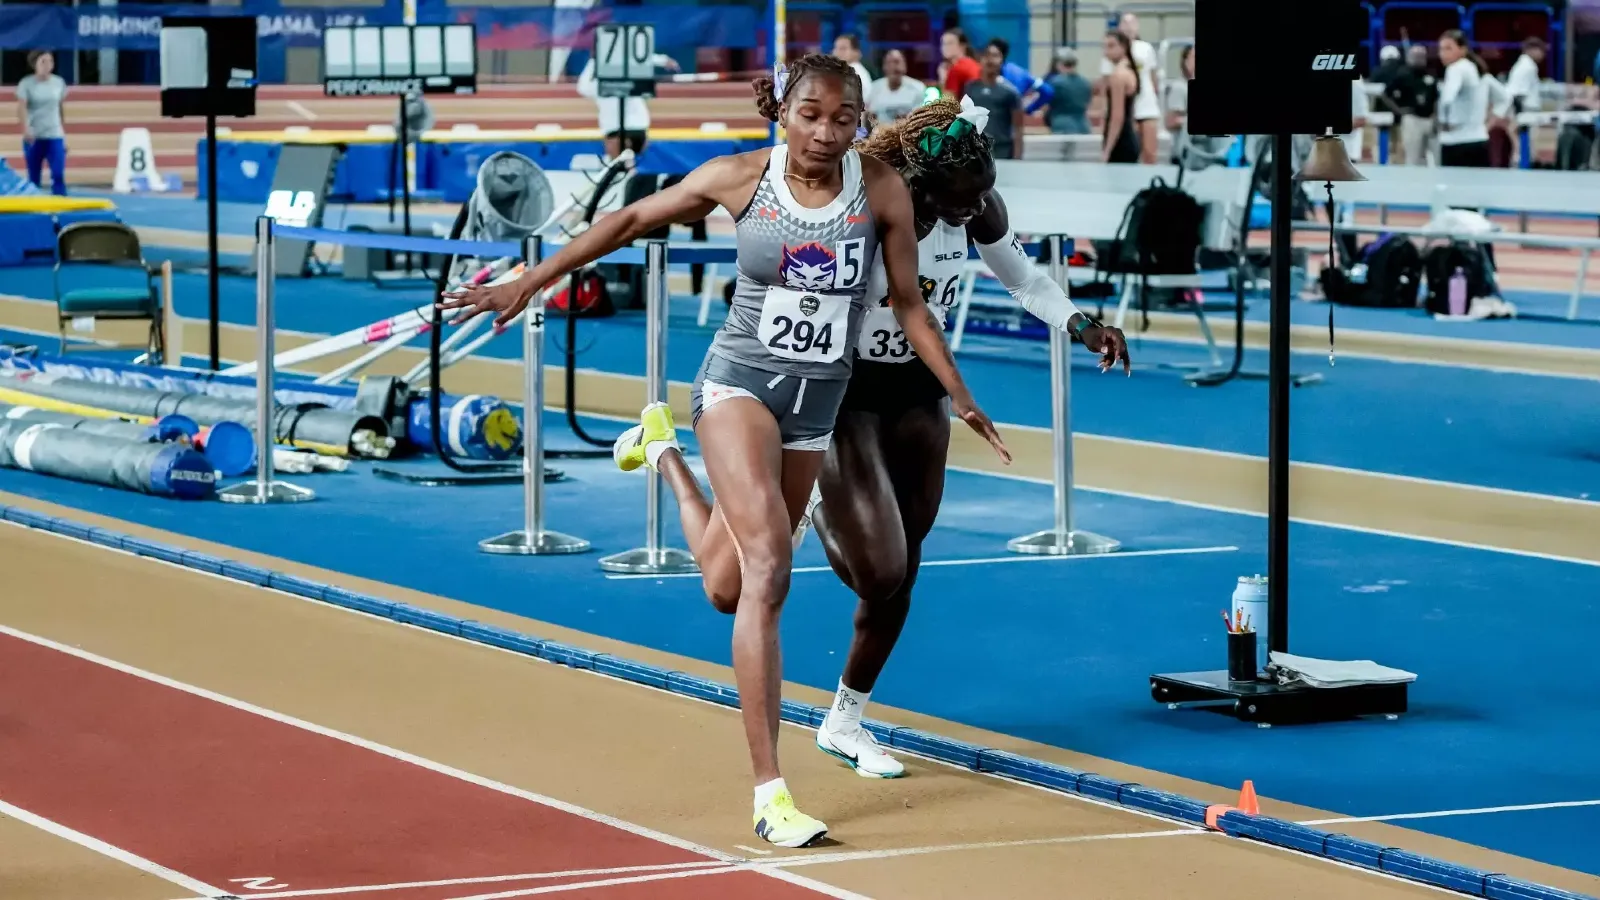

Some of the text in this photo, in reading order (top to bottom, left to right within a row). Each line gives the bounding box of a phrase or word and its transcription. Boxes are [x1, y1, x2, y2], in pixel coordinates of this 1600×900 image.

[78, 14, 162, 37] BIRMING
[256, 14, 322, 37] BAMA,
[603, 26, 650, 64] 70
[1311, 54, 1356, 70] GILL
[326, 78, 423, 96] PERFORMANCE
[130, 147, 146, 172] 8
[843, 242, 860, 286] 5
[935, 250, 964, 262] SLC
[940, 274, 960, 307] 6
[768, 315, 833, 355] 294
[869, 329, 917, 358] 33
